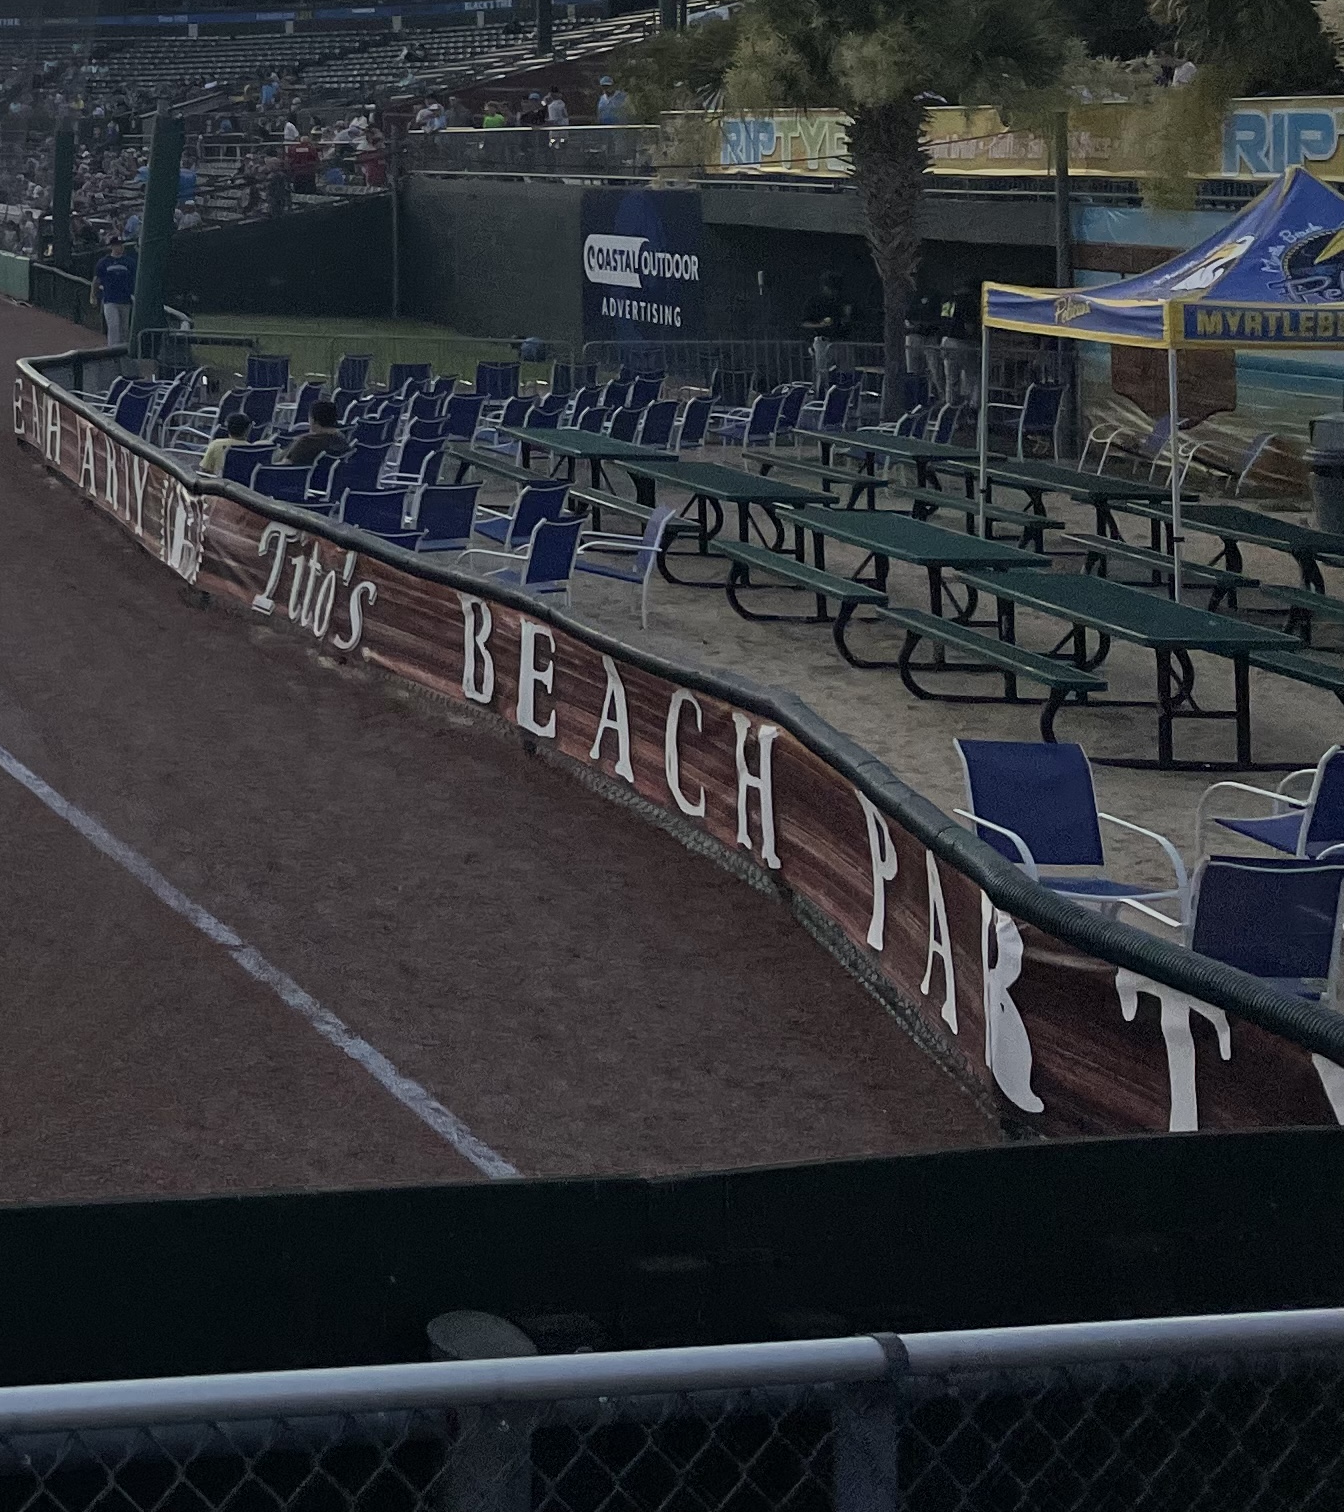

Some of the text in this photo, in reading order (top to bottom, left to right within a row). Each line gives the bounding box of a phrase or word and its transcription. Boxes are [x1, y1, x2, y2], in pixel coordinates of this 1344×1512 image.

[587, 245, 700, 281] COASTAL OUTDOOR
[601, 296, 681, 327] ADVERTISING
[252, 521, 378, 652] Tito's
[459, 592, 782, 870] BEACH
